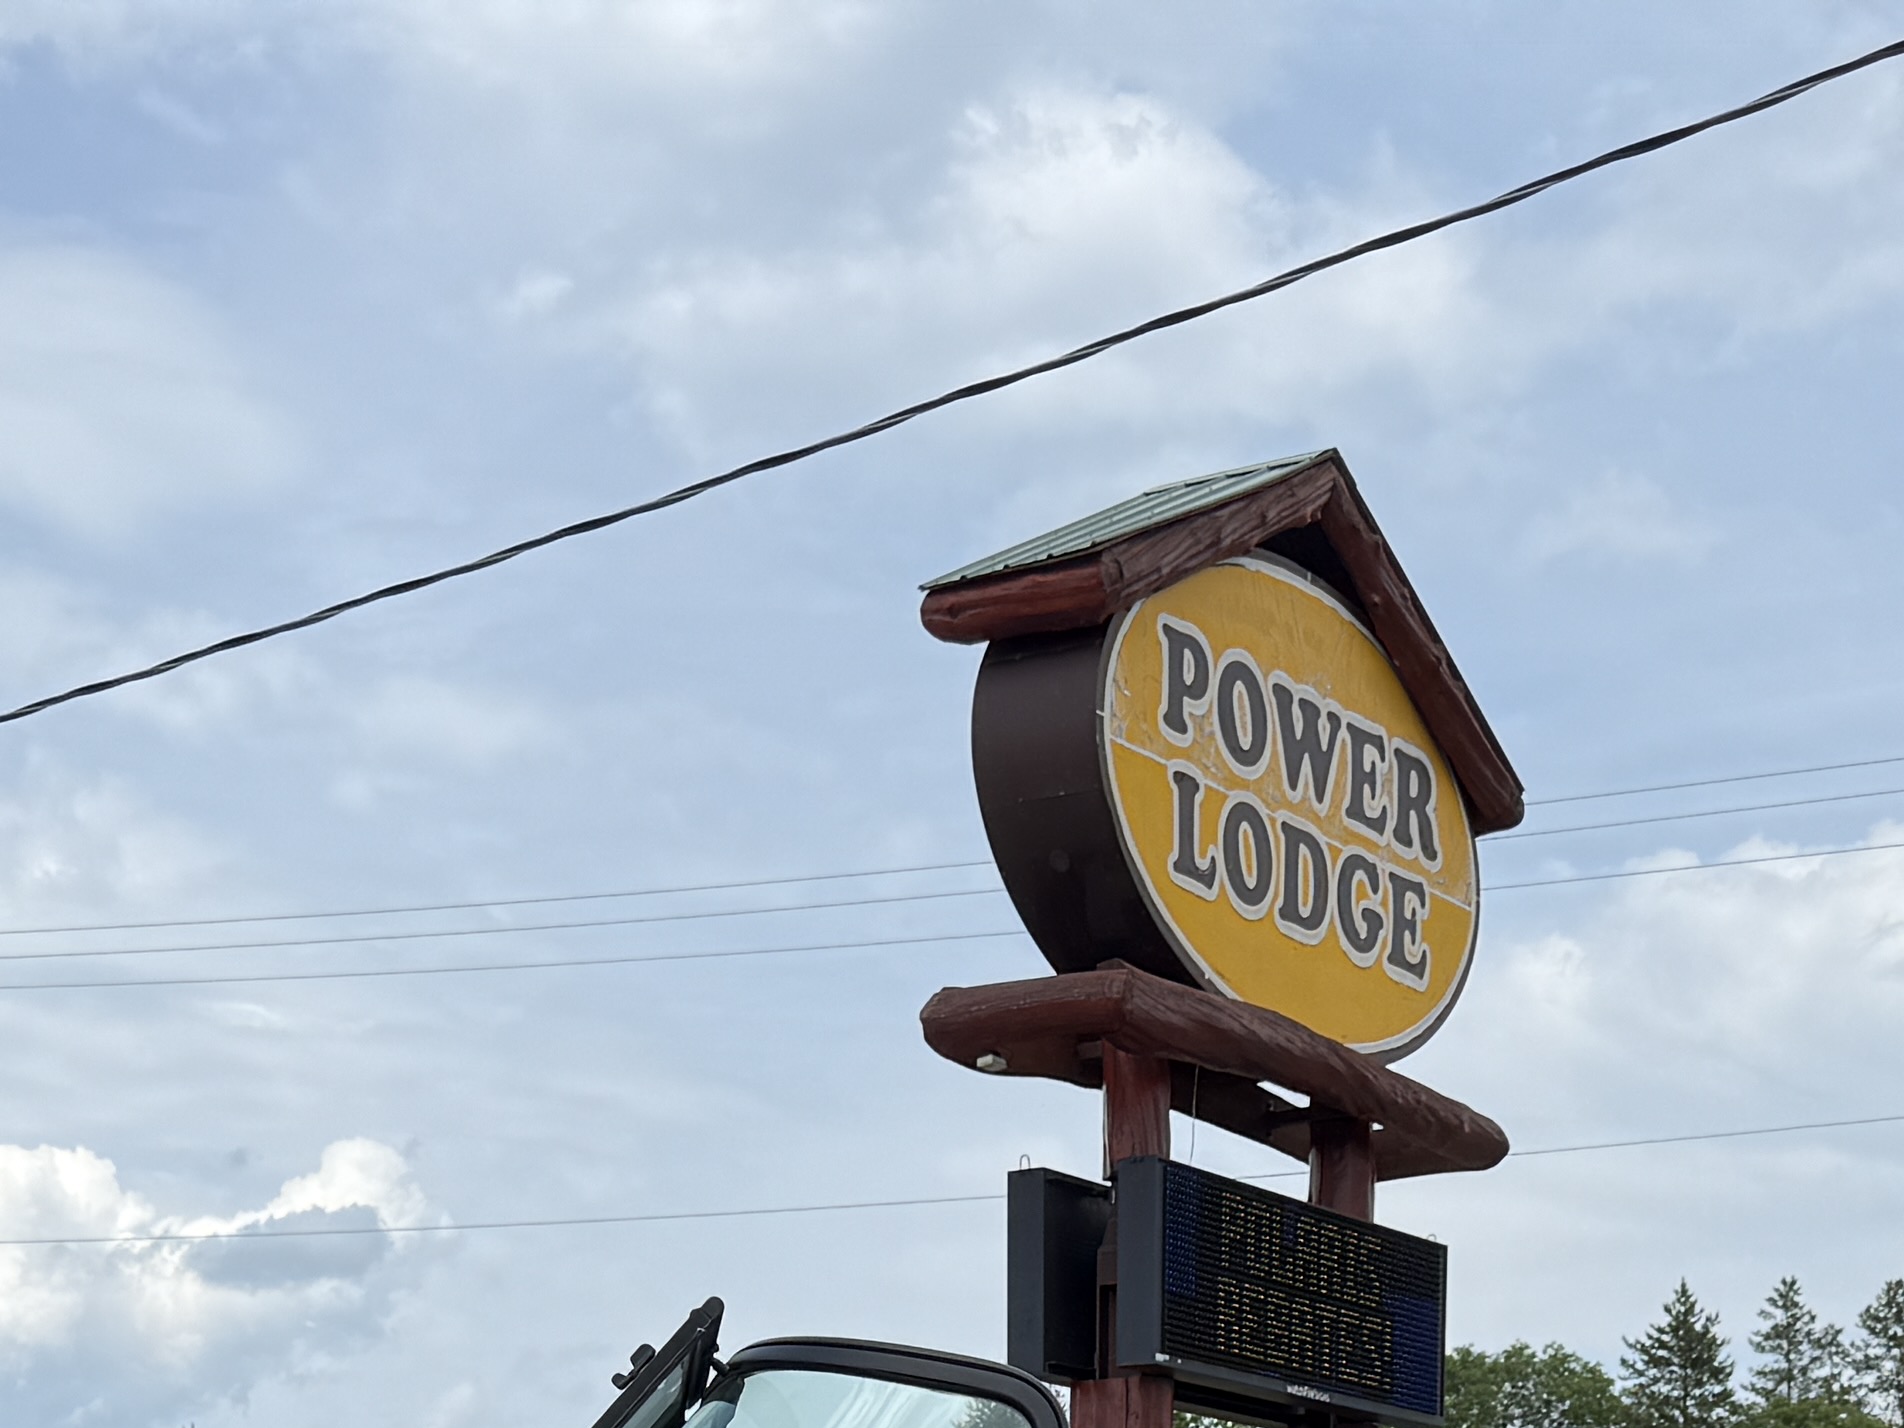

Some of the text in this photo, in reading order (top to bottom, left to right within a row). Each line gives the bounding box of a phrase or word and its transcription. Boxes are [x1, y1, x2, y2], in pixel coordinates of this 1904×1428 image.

[1157, 613, 1442, 871] POWER
[1167, 759, 1430, 992] LODGE
[1221, 1192, 1383, 1306] POLARIS
